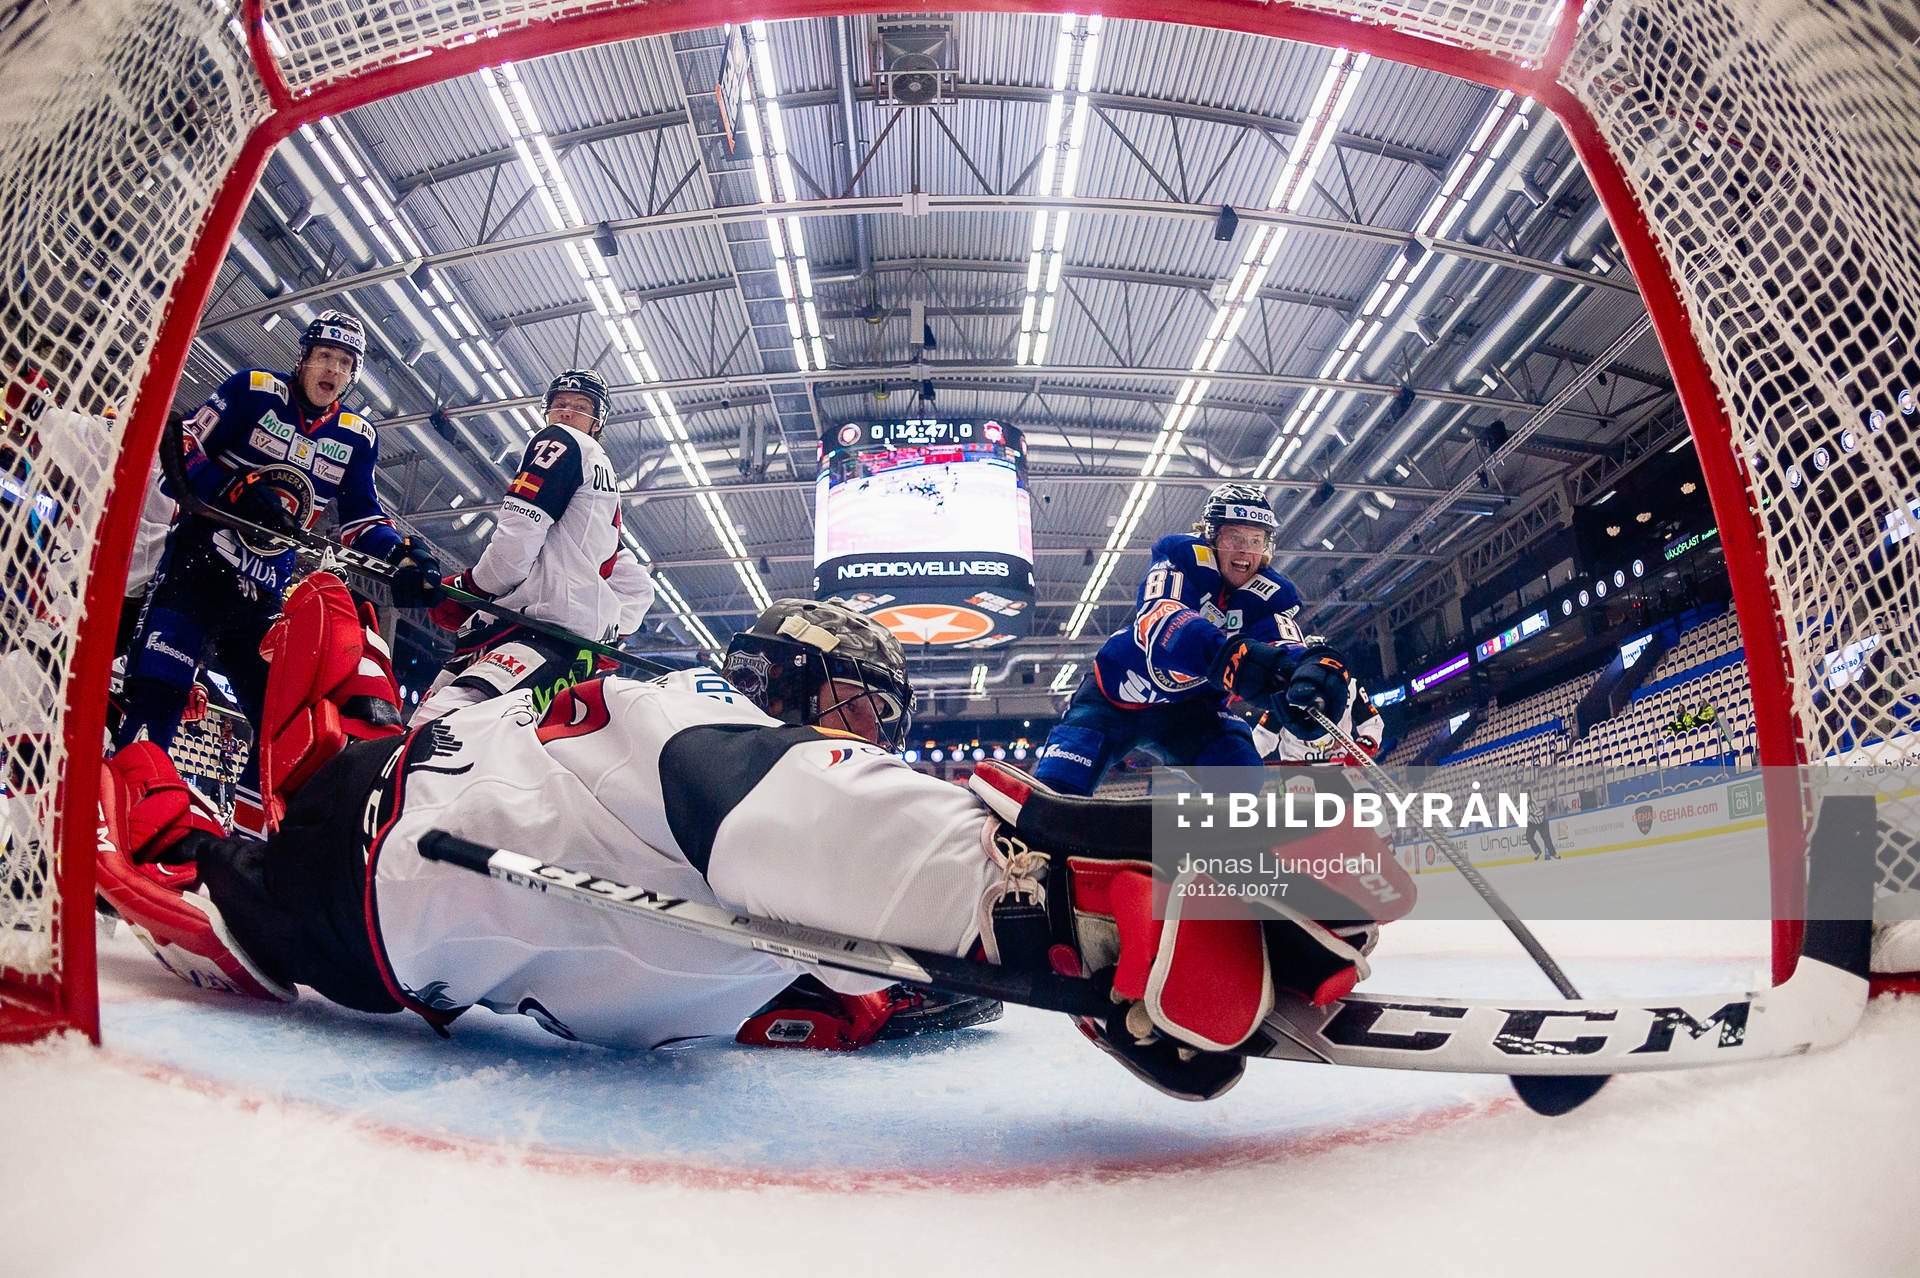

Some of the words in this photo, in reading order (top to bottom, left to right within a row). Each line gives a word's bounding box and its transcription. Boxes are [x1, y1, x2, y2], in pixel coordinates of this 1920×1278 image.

[262, 414, 290, 439] wilo
[895, 423, 948, 439] 14:47
[321, 442, 348, 461] wilo
[242, 545, 278, 588] VIDA
[837, 560, 1010, 581] NORDICWELLNESS
[1143, 570, 1184, 602] 81
[1249, 578, 1275, 597] put
[1659, 802, 1719, 823] GEHAB.com
[1736, 797, 1749, 810] ON
[530, 862, 689, 912] CCM
[1317, 999, 1751, 1056] CCM
